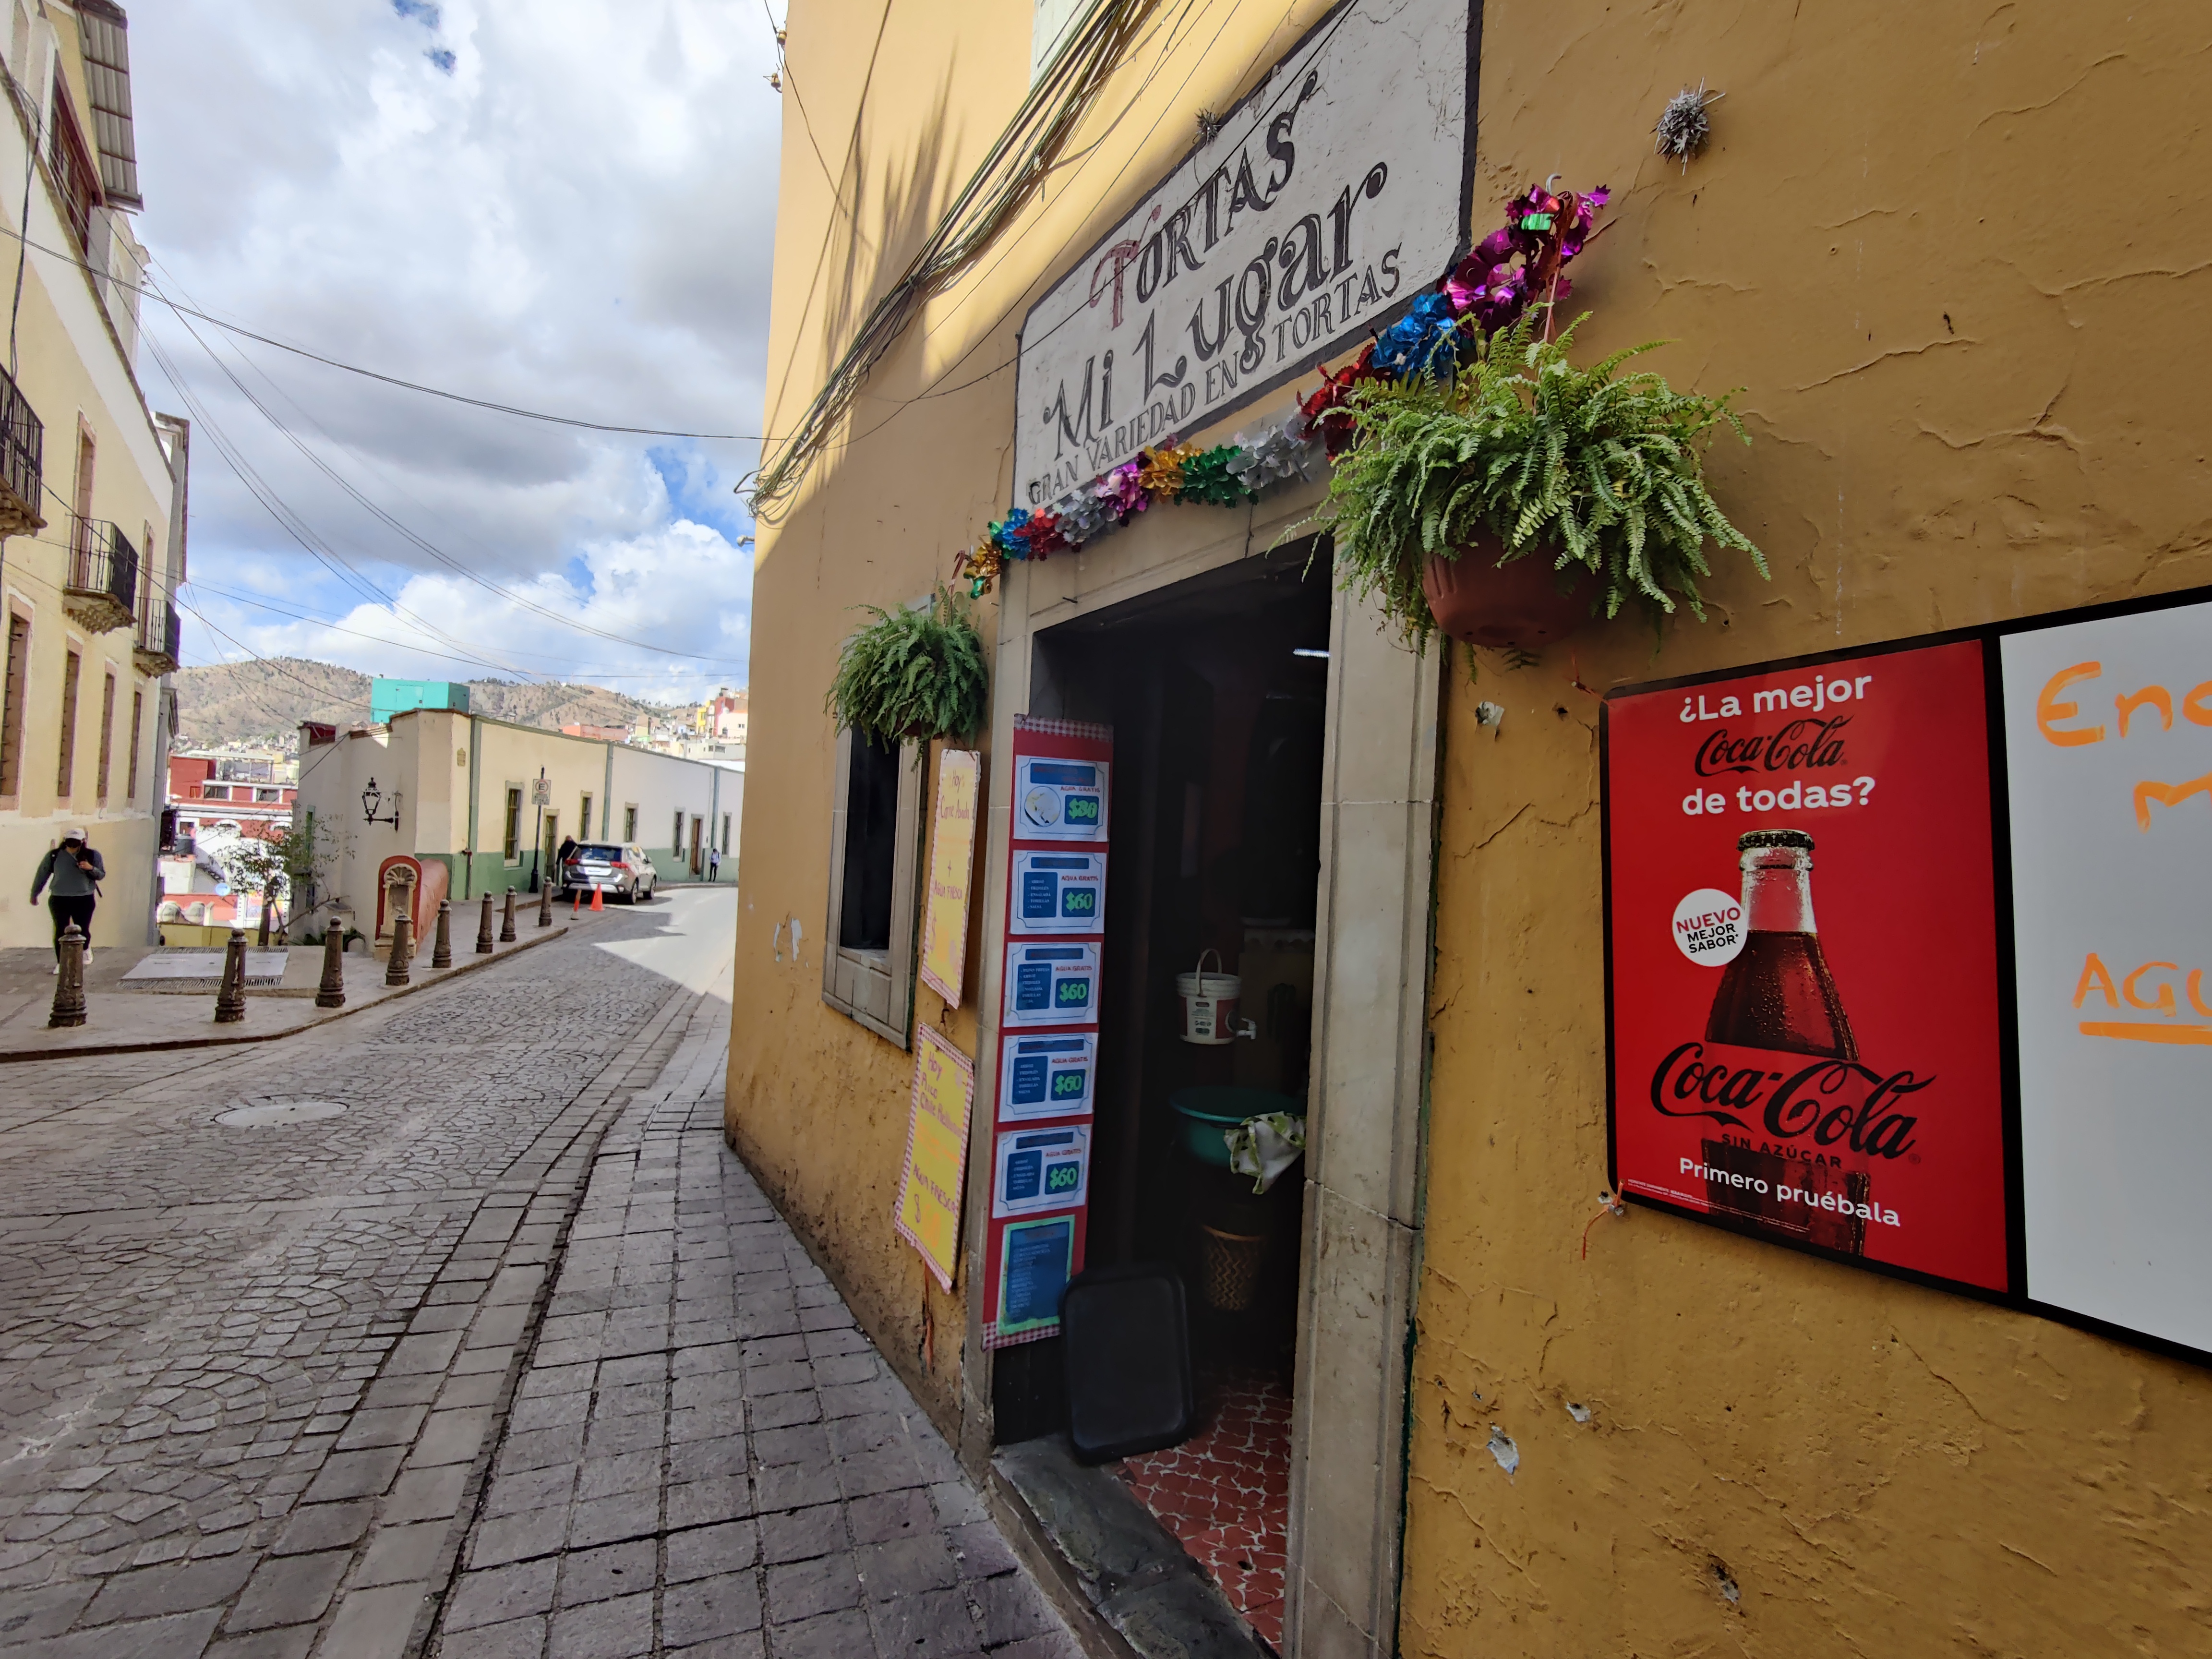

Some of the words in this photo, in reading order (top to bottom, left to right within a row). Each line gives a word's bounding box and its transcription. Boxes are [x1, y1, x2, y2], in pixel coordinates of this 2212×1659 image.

[1089, 69, 1318, 331] TORTAS
[1043, 349, 1114, 461] Mi
[1132, 162, 1387, 405] Lugar
[1028, 454, 1079, 505] GRAN
[1086, 383, 1196, 472] VARIEDAD
[1205, 358, 1238, 405] EN
[1272, 242, 1402, 362] TORTAS
[1679, 694, 1742, 723] ¿La
[1753, 675, 1872, 713] mejor
[1695, 715, 1855, 777] Coca-Cola
[1069, 798, 1098, 819] $80
[1682, 789, 1725, 815] de
[1736, 776, 1875, 812] todas?
[1066, 891, 1093, 912] $60
[1676, 907, 1741, 934] NUEVO
[1687, 923, 1736, 942] MEJOR
[1059, 982, 1087, 1002] $60
[928, 1050, 942, 1082] Hoy
[1055, 1075, 1082, 1096] $60
[1650, 1042, 1938, 1160] Coca-Cola
[1722, 1133, 1751, 1149] SIN
[1760, 1142, 1841, 1169] AZÚCAR
[1049, 1166, 1078, 1190] $60
[1679, 1156, 1769, 1194] Primero
[1777, 1183, 1901, 1228] pruébala
